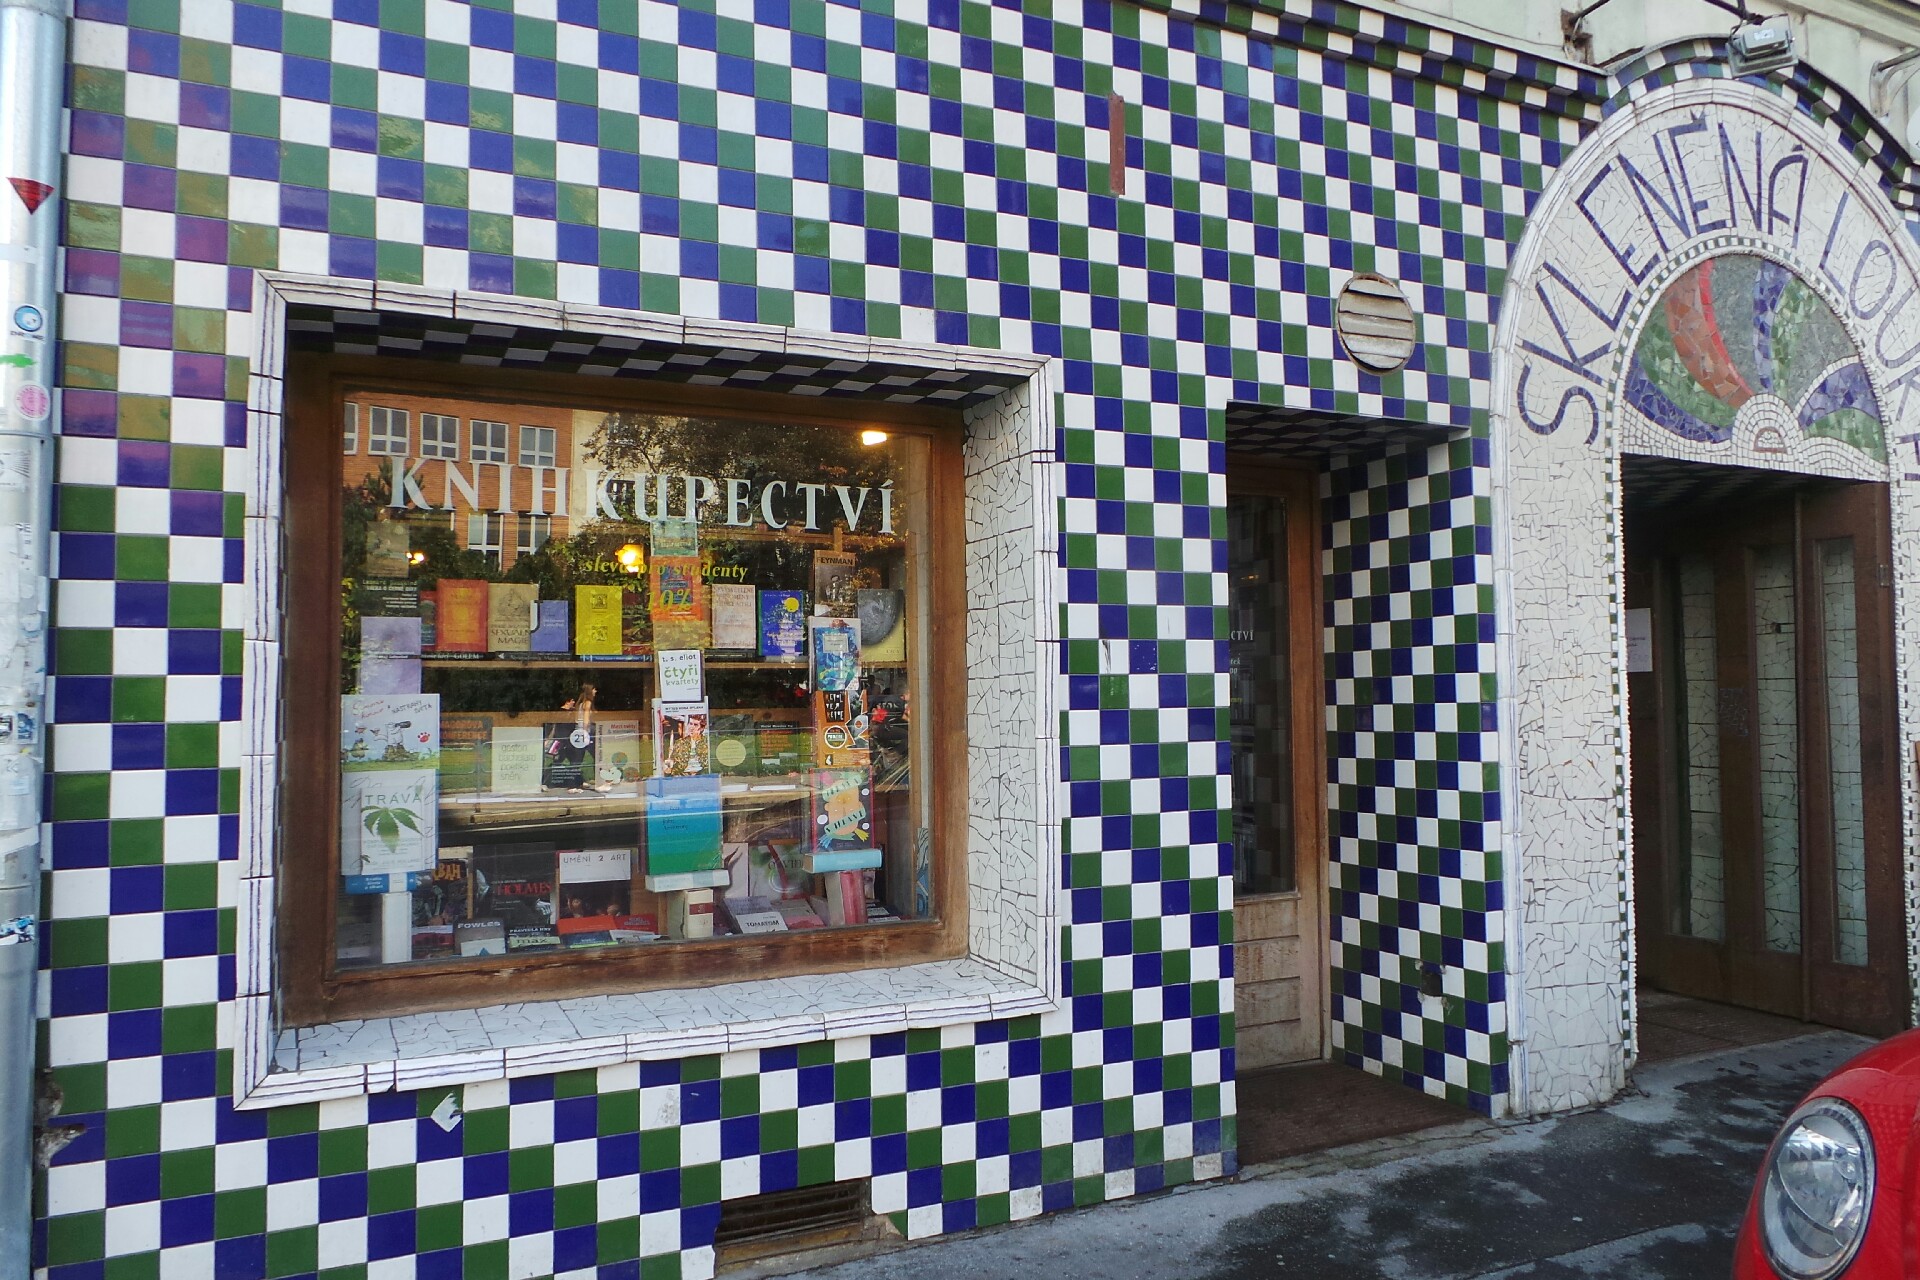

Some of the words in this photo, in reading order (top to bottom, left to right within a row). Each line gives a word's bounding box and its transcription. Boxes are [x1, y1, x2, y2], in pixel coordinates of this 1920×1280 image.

[1516, 108, 1807, 445] SKLENĚNÁ
[816, 556, 854, 567] FEYNMAN
[674, 561, 749, 582] studenty
[647, 588, 692, 611] 10%
[664, 664, 698, 680] čtyři
[665, 678, 699, 687] kvartety
[574, 734, 586, 744] 21
[610, 853, 627, 861] ART
[457, 921, 501, 930] FOWLES
